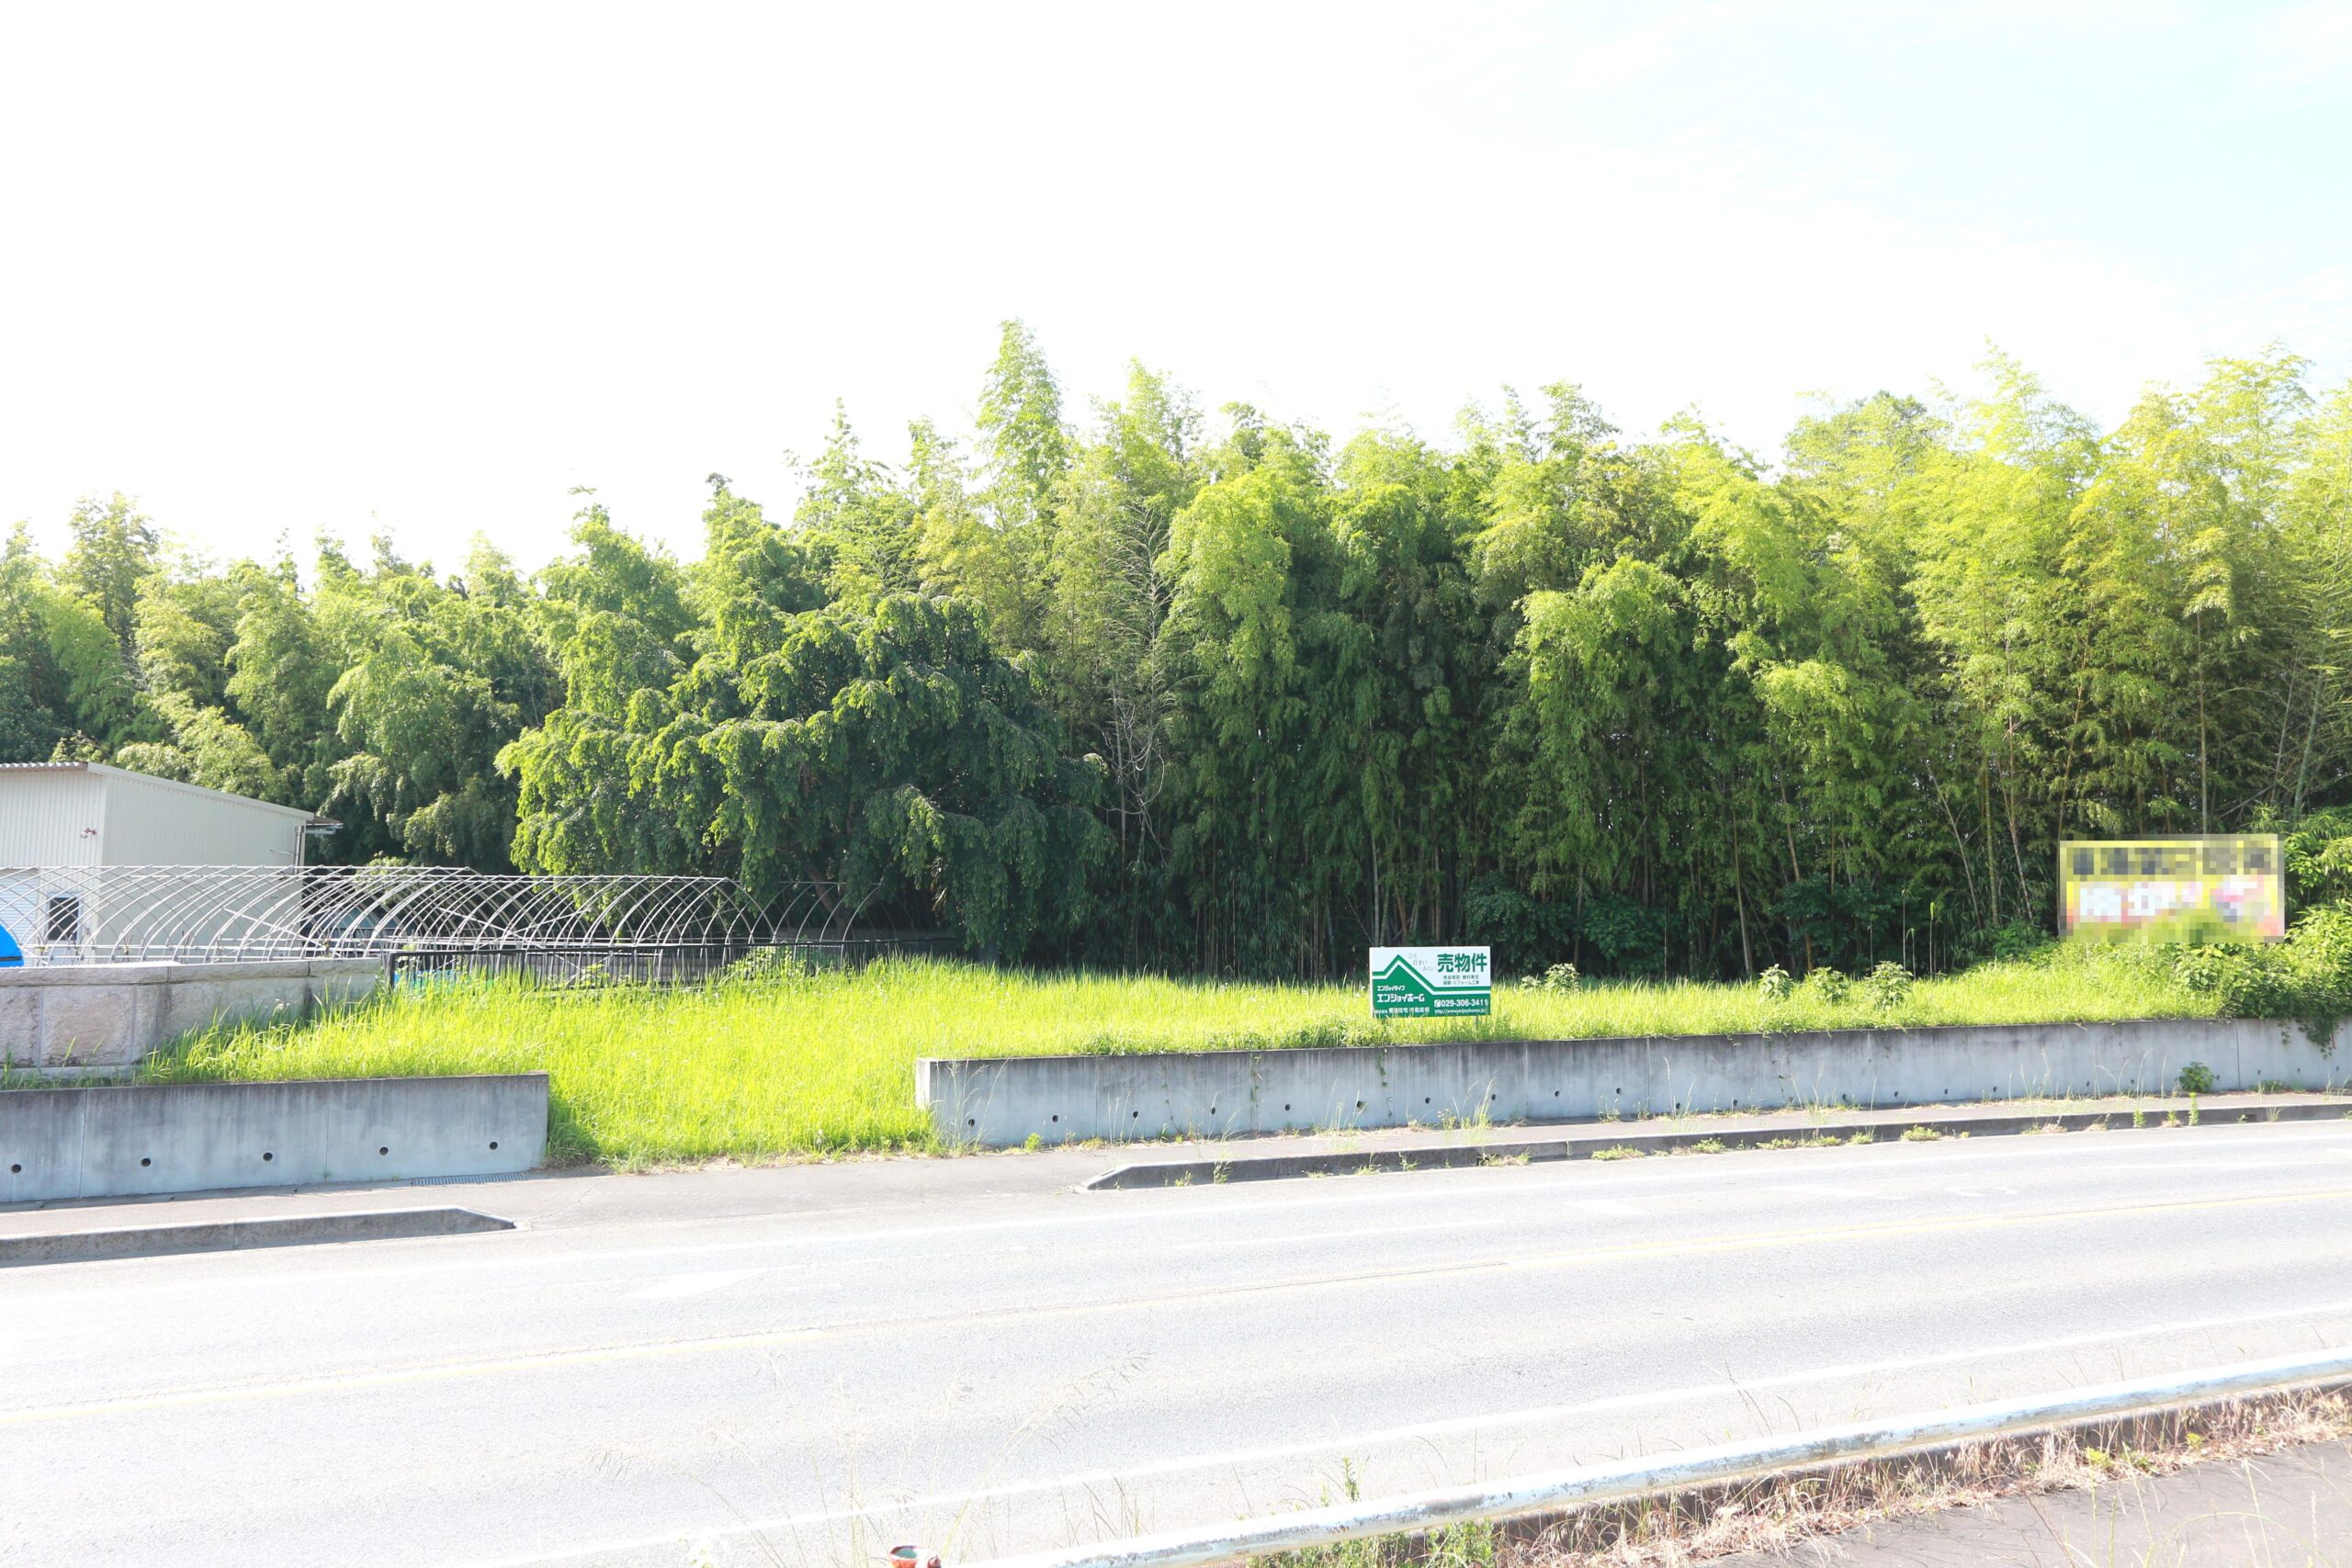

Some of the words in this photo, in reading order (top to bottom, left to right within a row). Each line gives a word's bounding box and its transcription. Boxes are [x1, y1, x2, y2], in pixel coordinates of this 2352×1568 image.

[1437, 953, 1487, 973] 売物件
[1377, 993, 1425, 1003] エンジョイホーム
